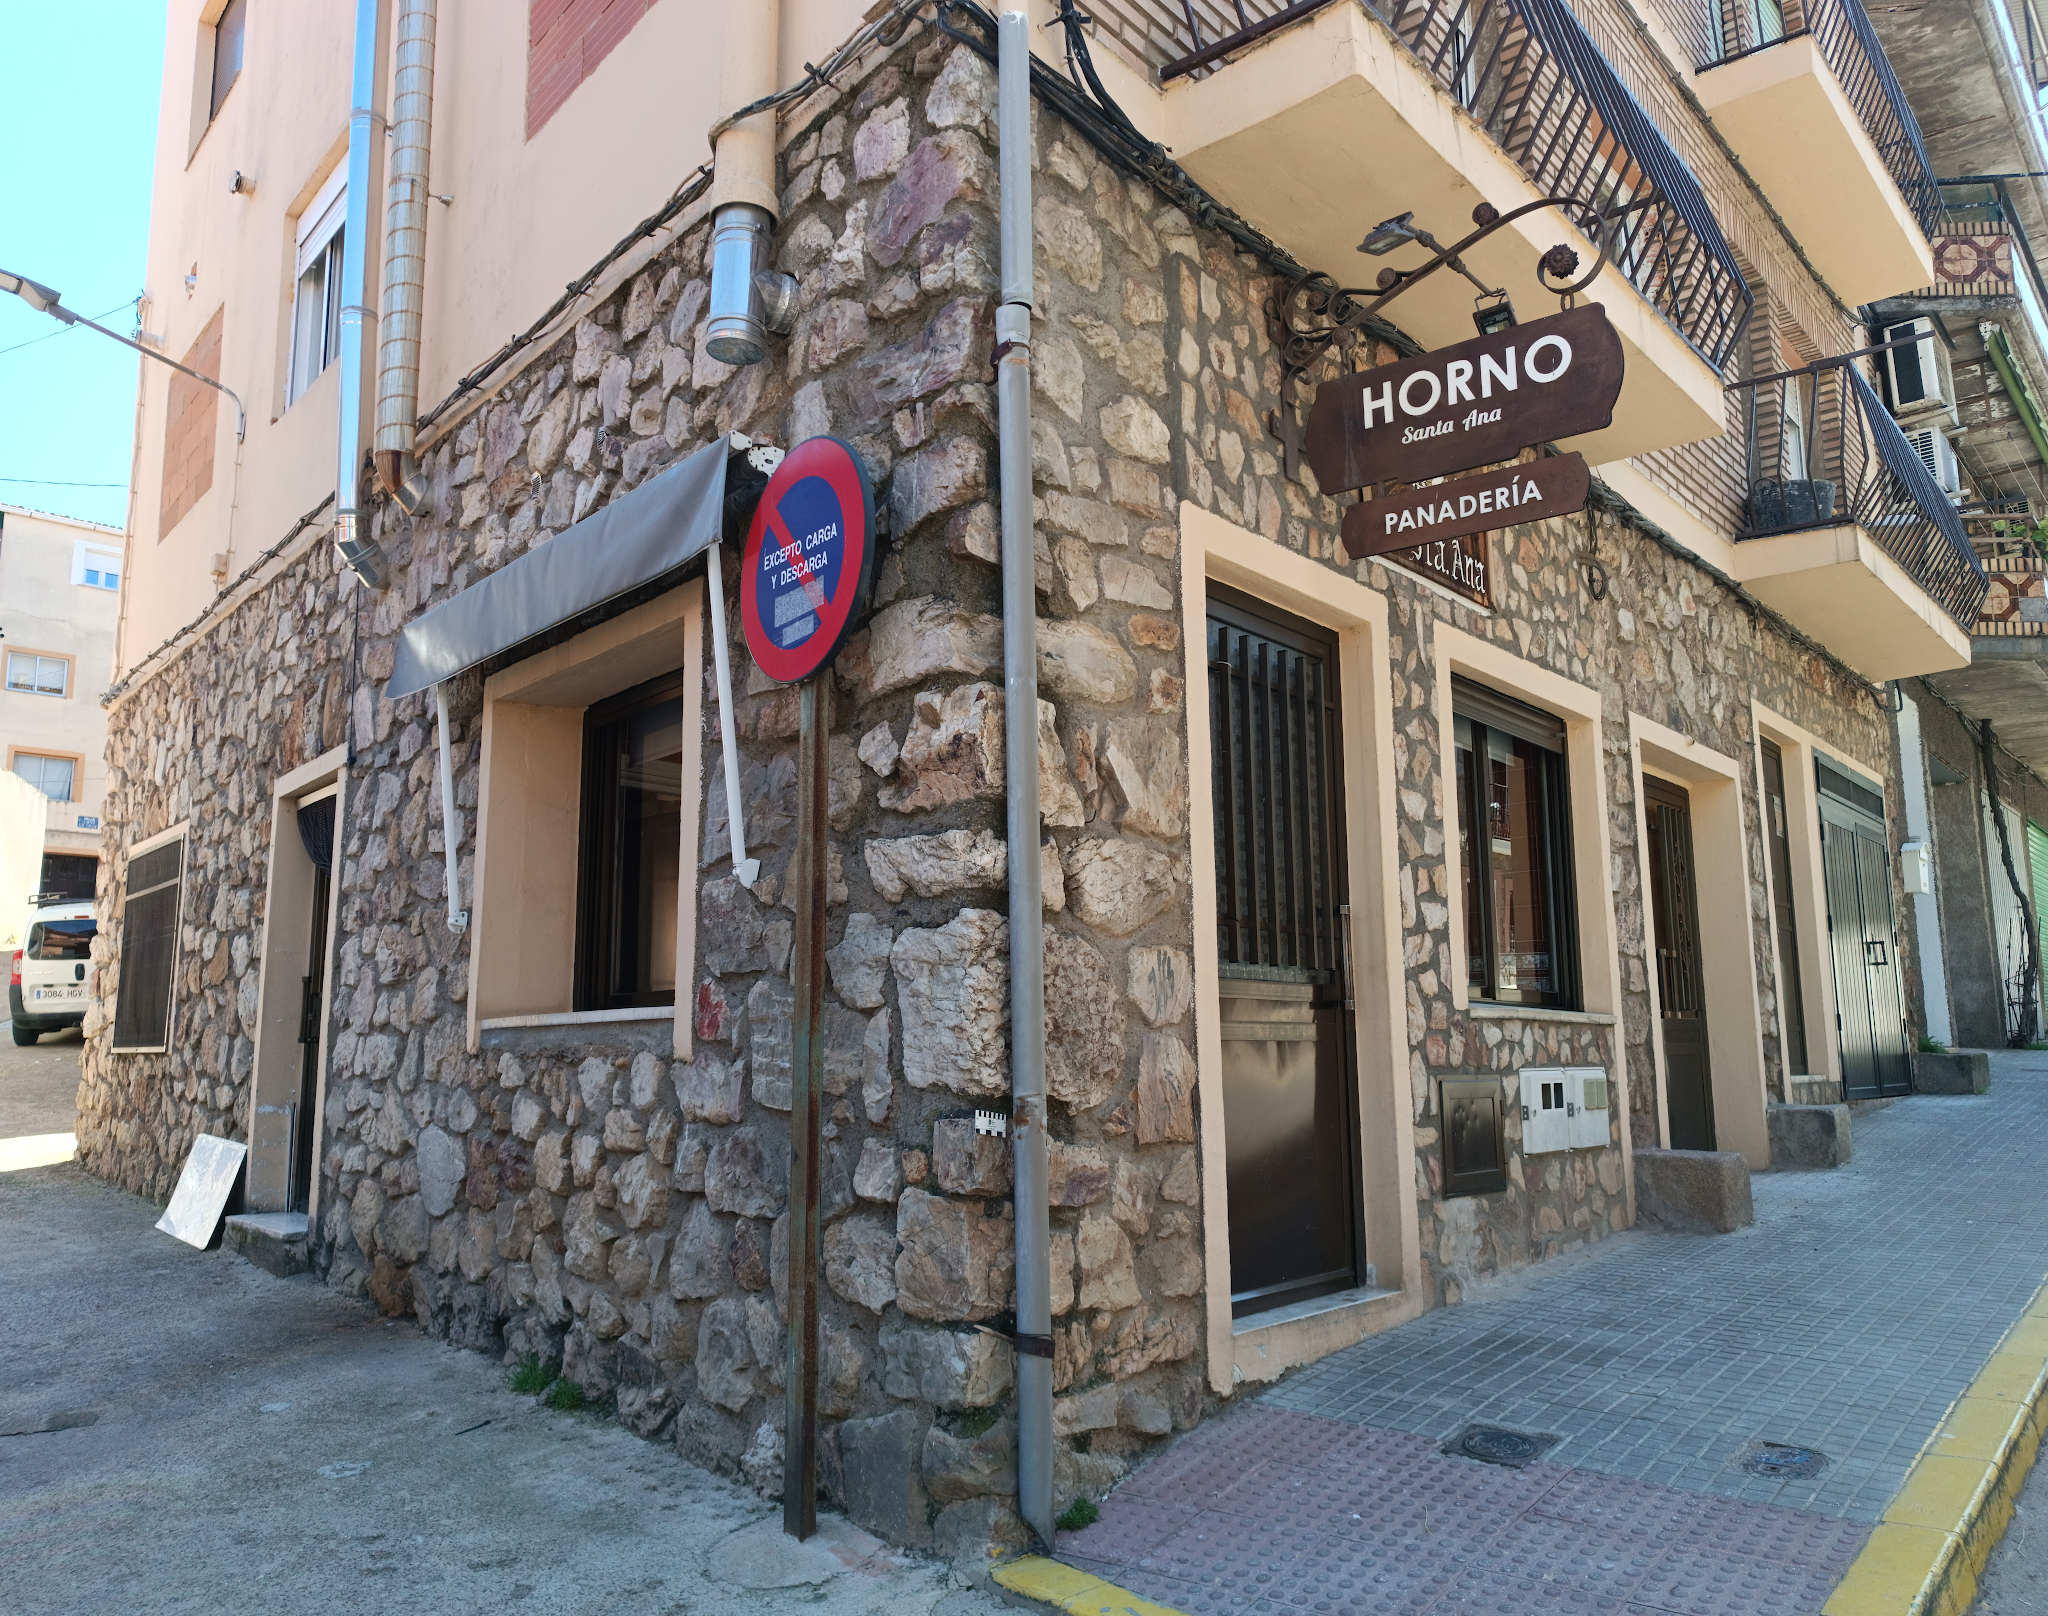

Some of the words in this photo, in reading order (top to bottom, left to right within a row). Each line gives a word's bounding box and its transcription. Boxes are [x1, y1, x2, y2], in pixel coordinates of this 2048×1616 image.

[1362, 334, 1573, 430] HORNO
[1401, 419, 1454, 445] Santa
[1461, 407, 1502, 431] Ana
[1385, 474, 1543, 535] PANADERÍA
[763, 539, 802, 571] EXCEPTO
[805, 522, 838, 551] CARGA
[771, 574, 778, 590] Y
[780, 551, 828, 586] DESCARGA
[1451, 539, 1486, 594] Ana
[42, 990, 63, 998] 3084
[66, 989, 83, 997] HGV
